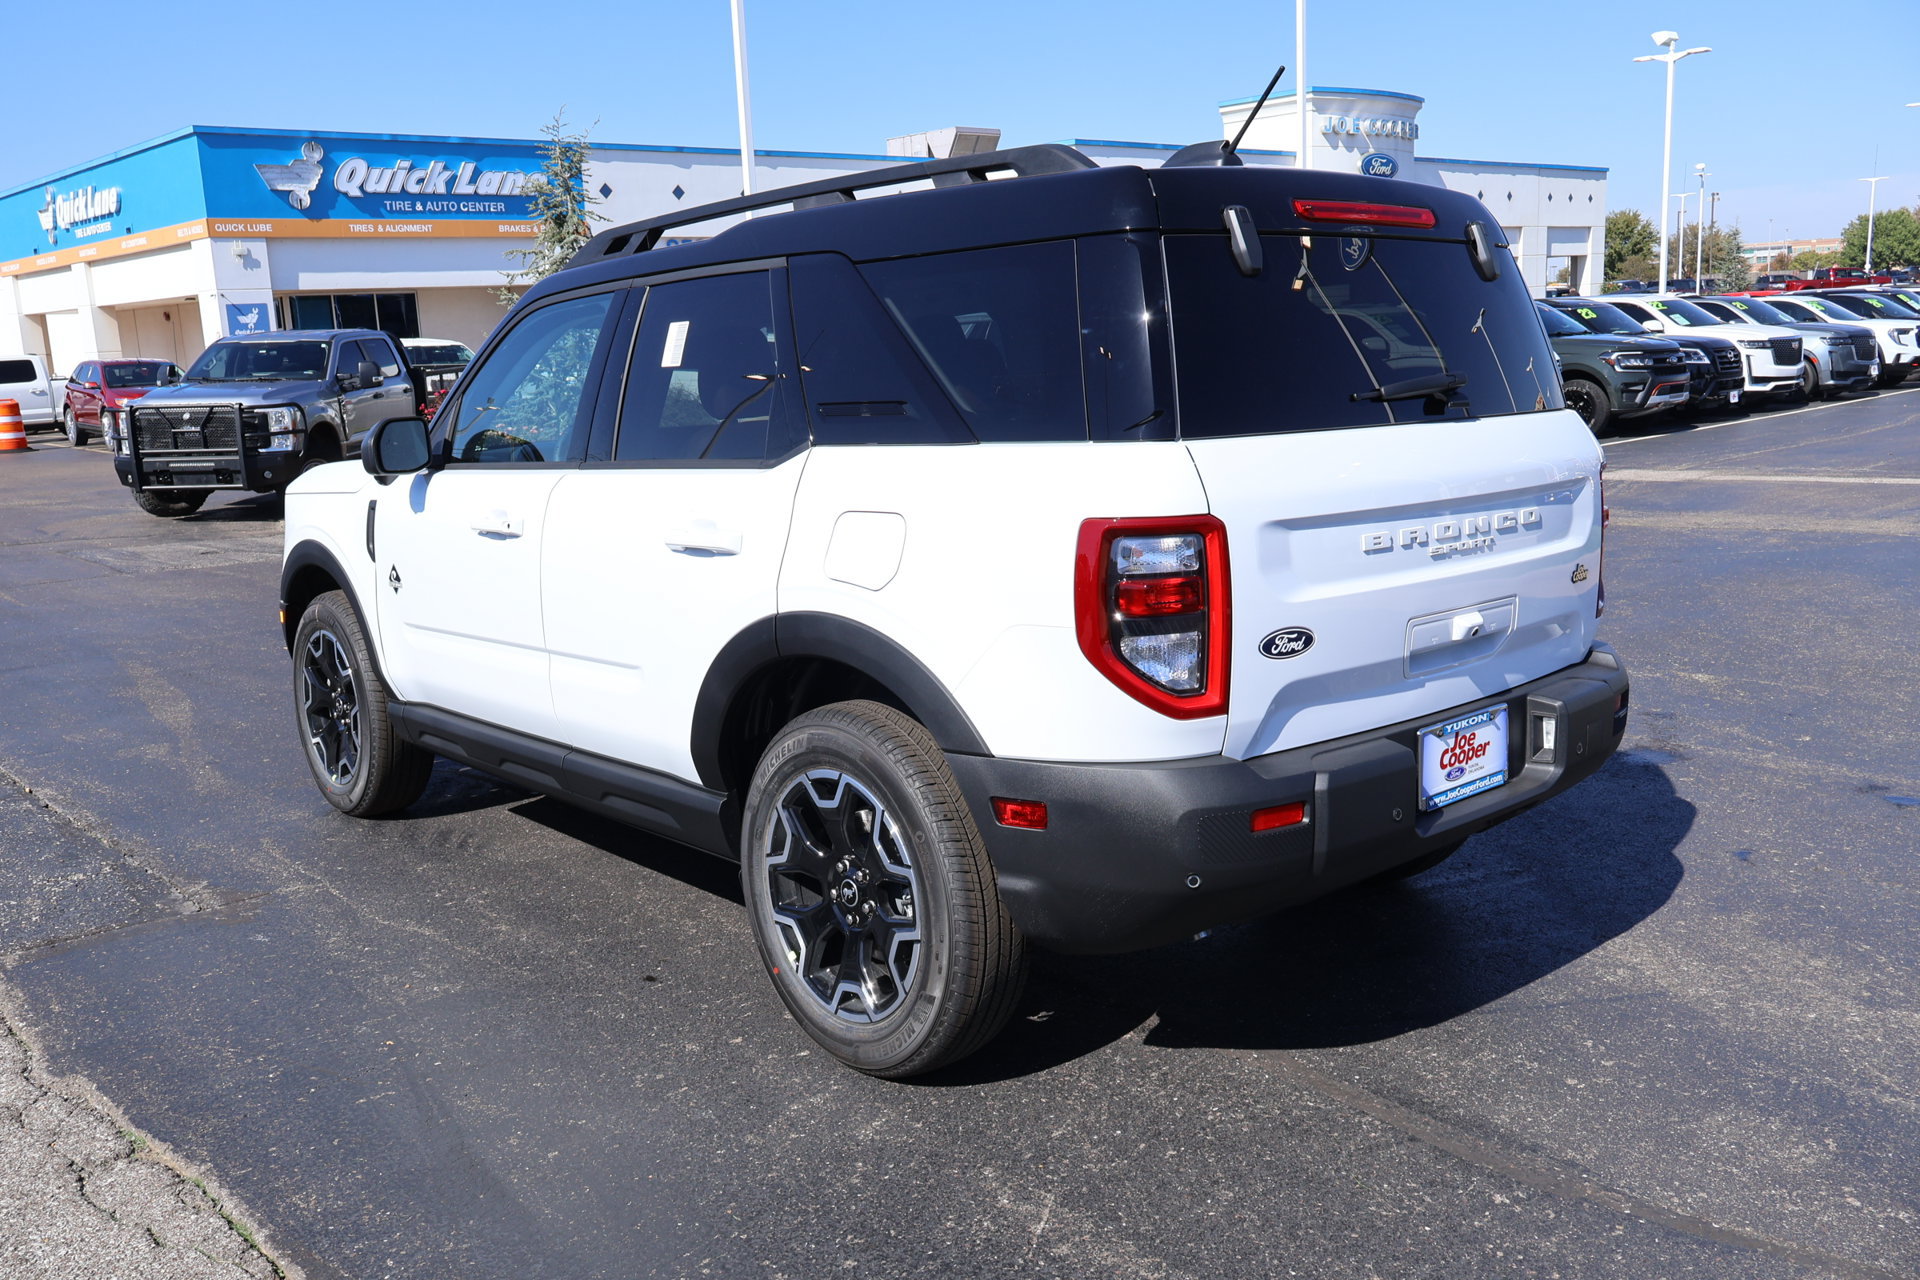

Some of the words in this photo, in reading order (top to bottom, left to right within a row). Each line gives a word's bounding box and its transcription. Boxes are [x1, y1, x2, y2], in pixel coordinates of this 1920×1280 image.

[1322, 116, 1361, 134] JOE
[1368, 118, 1419, 140] COOPER
[334, 159, 455, 198] Quick
[451, 161, 549, 196] Lane
[56, 188, 87, 229] Quick
[87, 185, 117, 218] Lane
[384, 200, 412, 212] TIRE
[415, 202, 423, 212] &
[426, 201, 457, 212] AUTO
[460, 201, 505, 213] CENTER
[214, 223, 245, 233] QUICK
[247, 223, 273, 233] LUBE
[348, 224, 374, 233] TIRES
[377, 224, 384, 233] &
[385, 224, 433, 233] ALIGNMENT
[498, 224, 531, 233] BRAKES
[532, 224, 539, 233] &
[1361, 507, 1541, 551] BRONCO
[1429, 536, 1495, 556] SPORT
[1271, 633, 1306, 654] Ford
[1445, 712, 1488, 733] YUKON
[1449, 731, 1477, 754] Joe
[760, 733, 808, 784] MICHELIN
[1439, 740, 1491, 770] Cooper
[1427, 773, 1504, 807] www.JoeCooperFord.com
